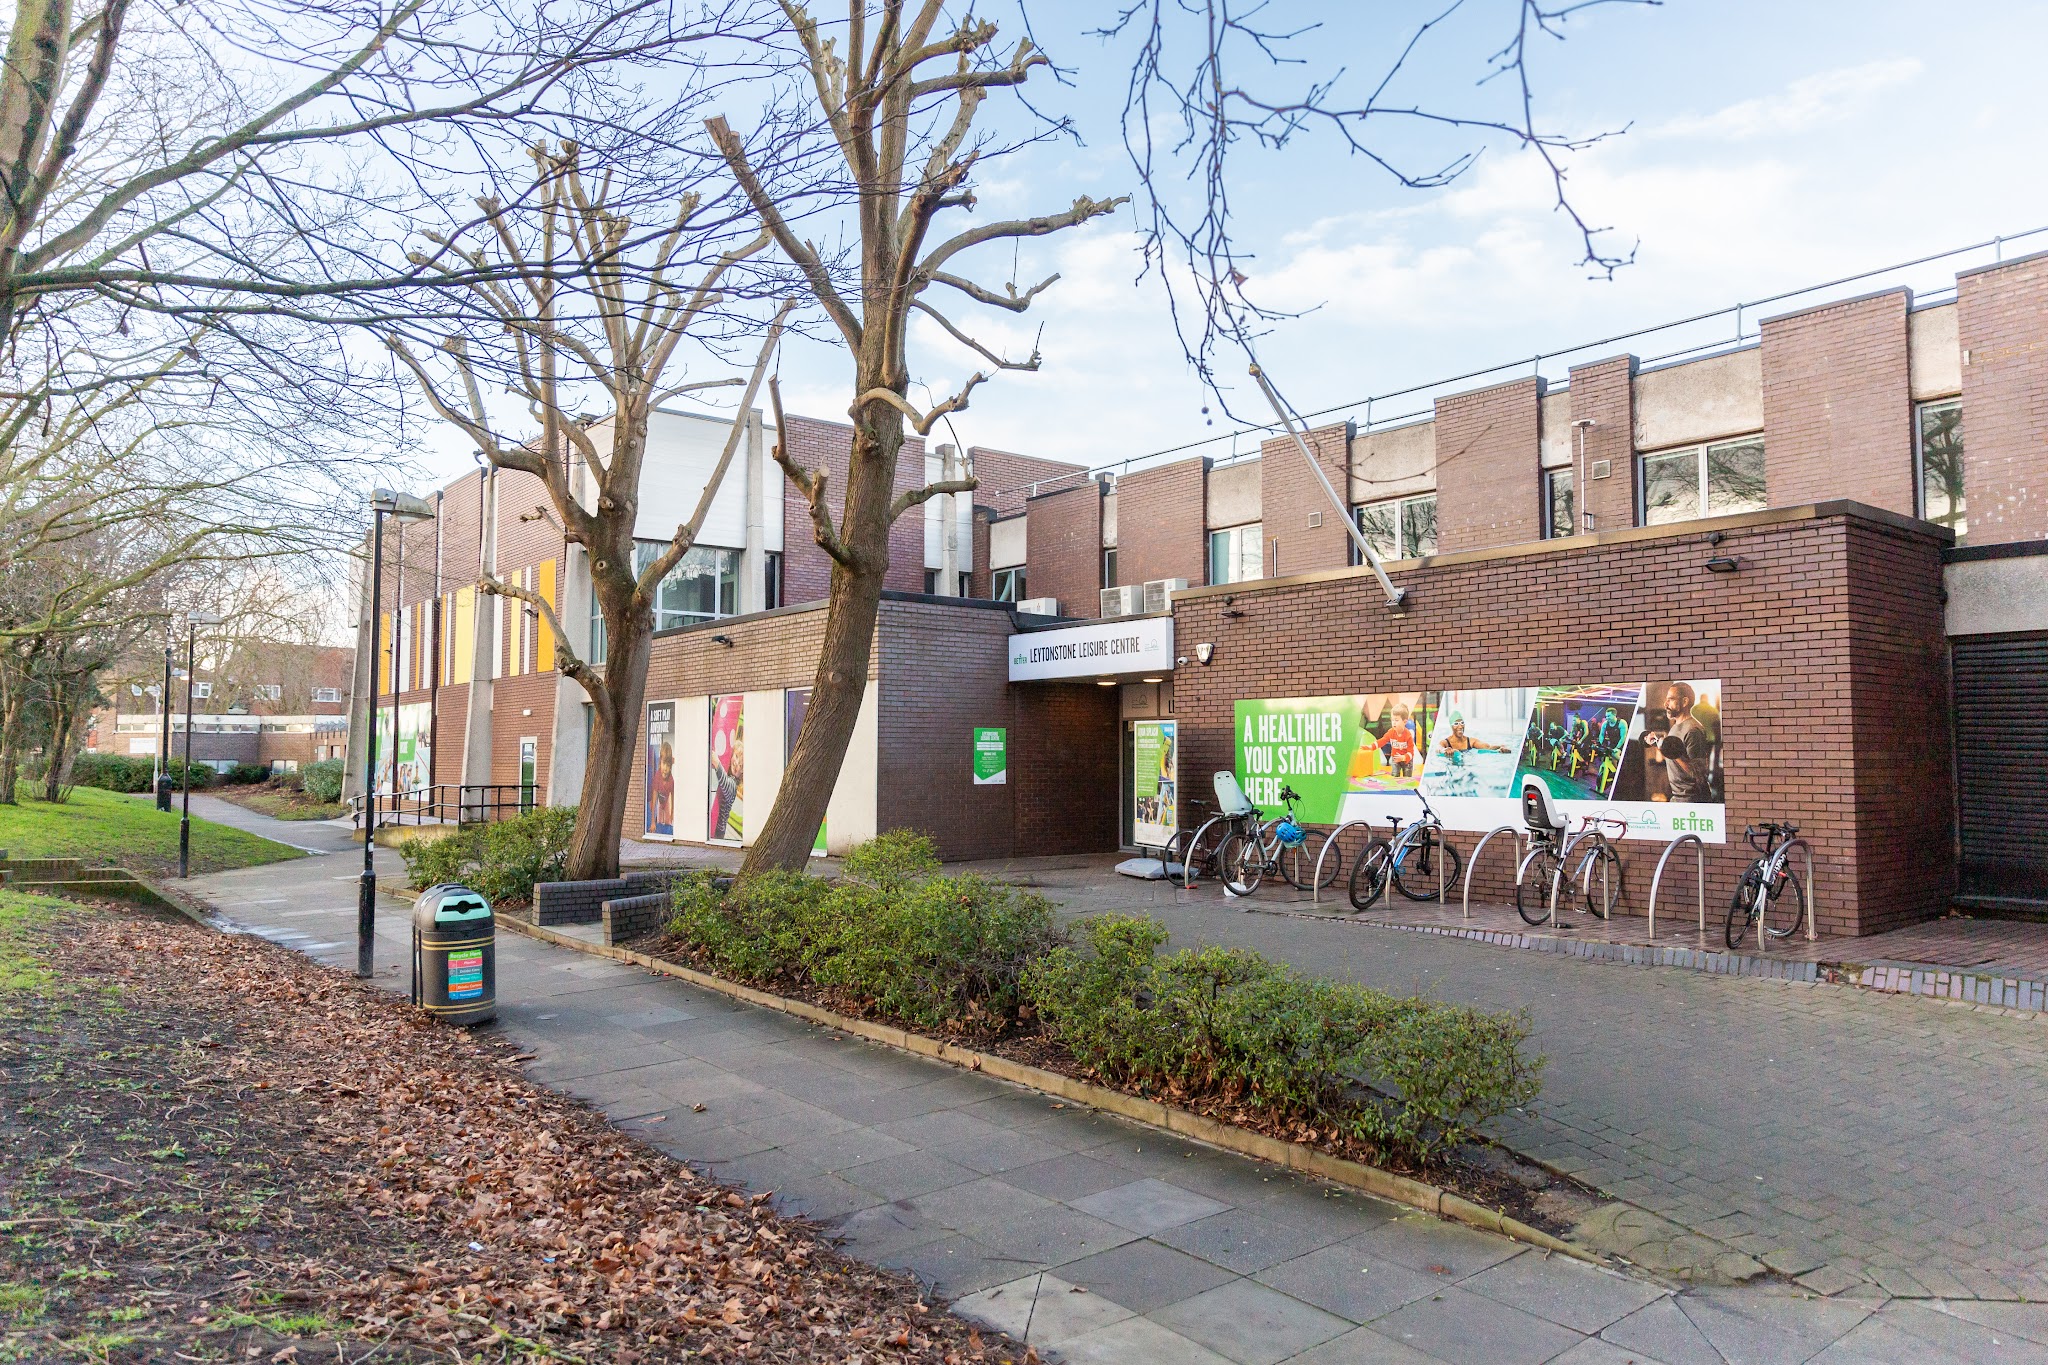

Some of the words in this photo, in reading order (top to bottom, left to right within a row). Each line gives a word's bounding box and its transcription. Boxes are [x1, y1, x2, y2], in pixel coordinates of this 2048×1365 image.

[1030, 644, 1077, 663] LEYTONSTONE
[1078, 640, 1108, 658] LEISURE
[1110, 637, 1140, 655] CENTRE
[1243, 715, 1253, 743] A
[1258, 712, 1342, 743] HEALTHIER
[1243, 745, 1273, 774] YOU
[1277, 745, 1337, 775] STARTS
[1244, 777, 1283, 806] HERE
[1672, 816, 1714, 832] BETTER
[450, 952, 469, 960] Recycle
